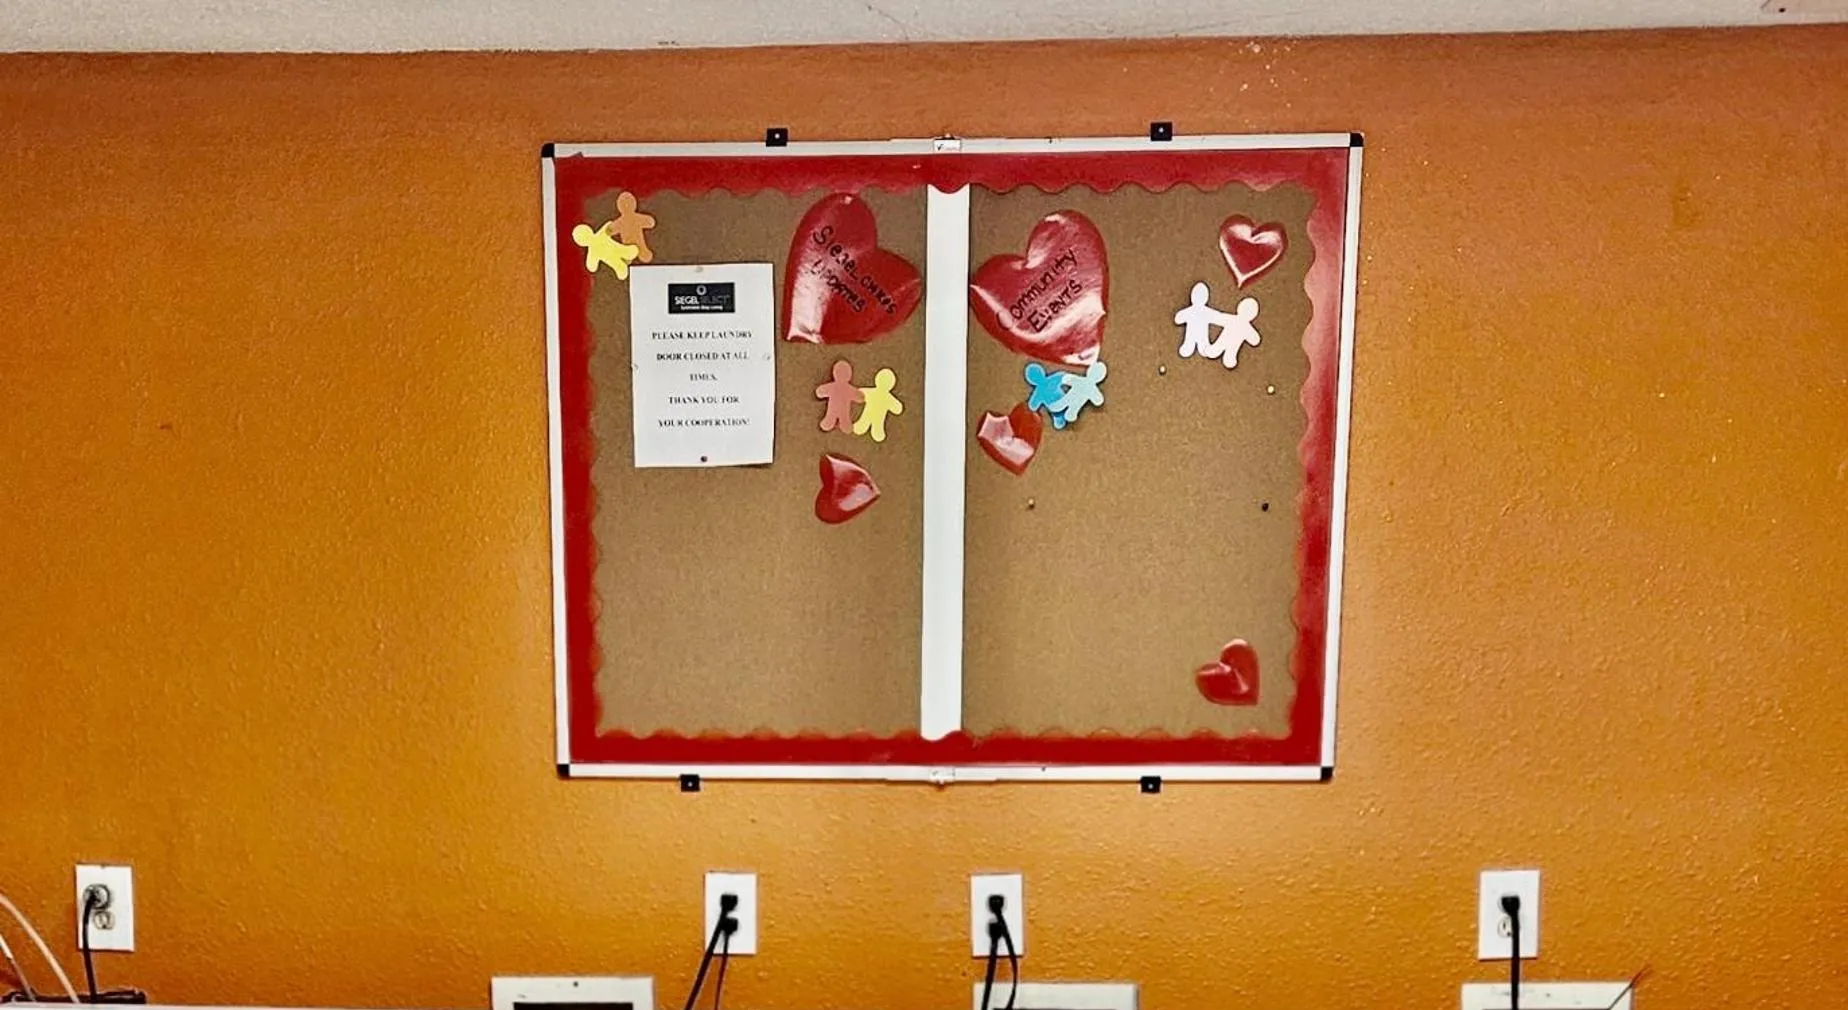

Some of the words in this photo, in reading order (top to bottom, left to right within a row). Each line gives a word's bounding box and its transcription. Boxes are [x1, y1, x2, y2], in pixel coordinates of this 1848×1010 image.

[652, 331, 683, 340] PLEASE
[687, 331, 710, 339] KEEP
[711, 330, 752, 339] LAUNDRY
[656, 353, 682, 361] DOOR
[684, 352, 718, 360] CLOSED
[721, 352, 731, 360] AT
[733, 352, 748, 360] ALL
[669, 396, 699, 404] THANK
[701, 396, 718, 404] YOU
[721, 396, 740, 404] FOR
[658, 419, 683, 427] YOUR
